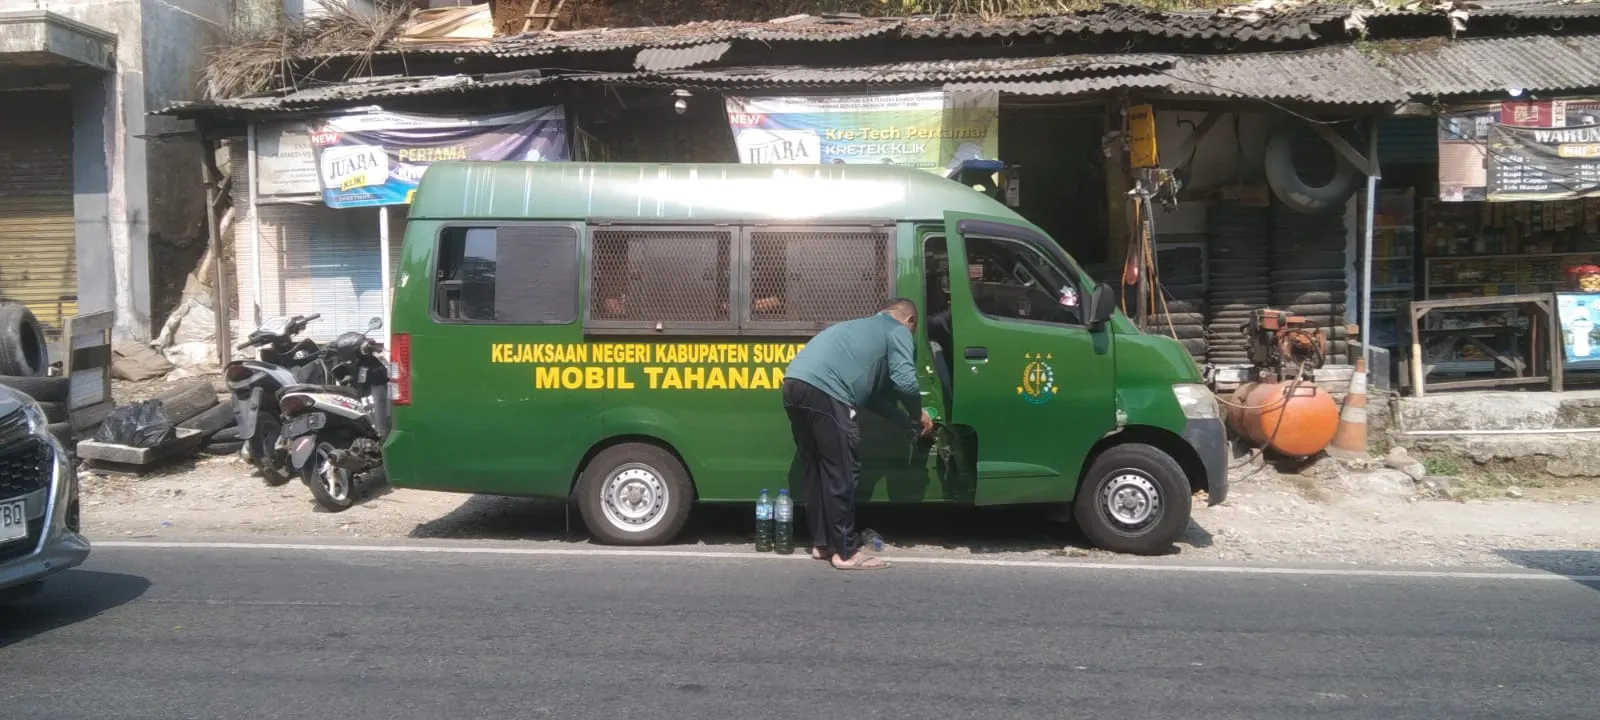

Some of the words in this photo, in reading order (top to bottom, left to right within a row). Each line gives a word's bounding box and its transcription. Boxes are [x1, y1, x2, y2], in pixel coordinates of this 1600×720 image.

[730, 114, 761, 125] NEW
[311, 133, 338, 144] NEW
[825, 126, 902, 141] Kre-Tech
[907, 124, 988, 140] Pertama!
[398, 146, 466, 162] PERTAMA
[749, 139, 809, 164] JUARA
[826, 143, 889, 156] KRETEK
[891, 142, 926, 155] KLIK
[329, 152, 379, 180] JUARA
[343, 174, 366, 188] KLIK!
[491, 343, 587, 364] KEJAKSAAN
[592, 343, 650, 363] NEGERI
[655, 343, 748, 363] KABUPATEN
[535, 367, 634, 389] MOBIL
[644, 366, 785, 389] TAHANAN
